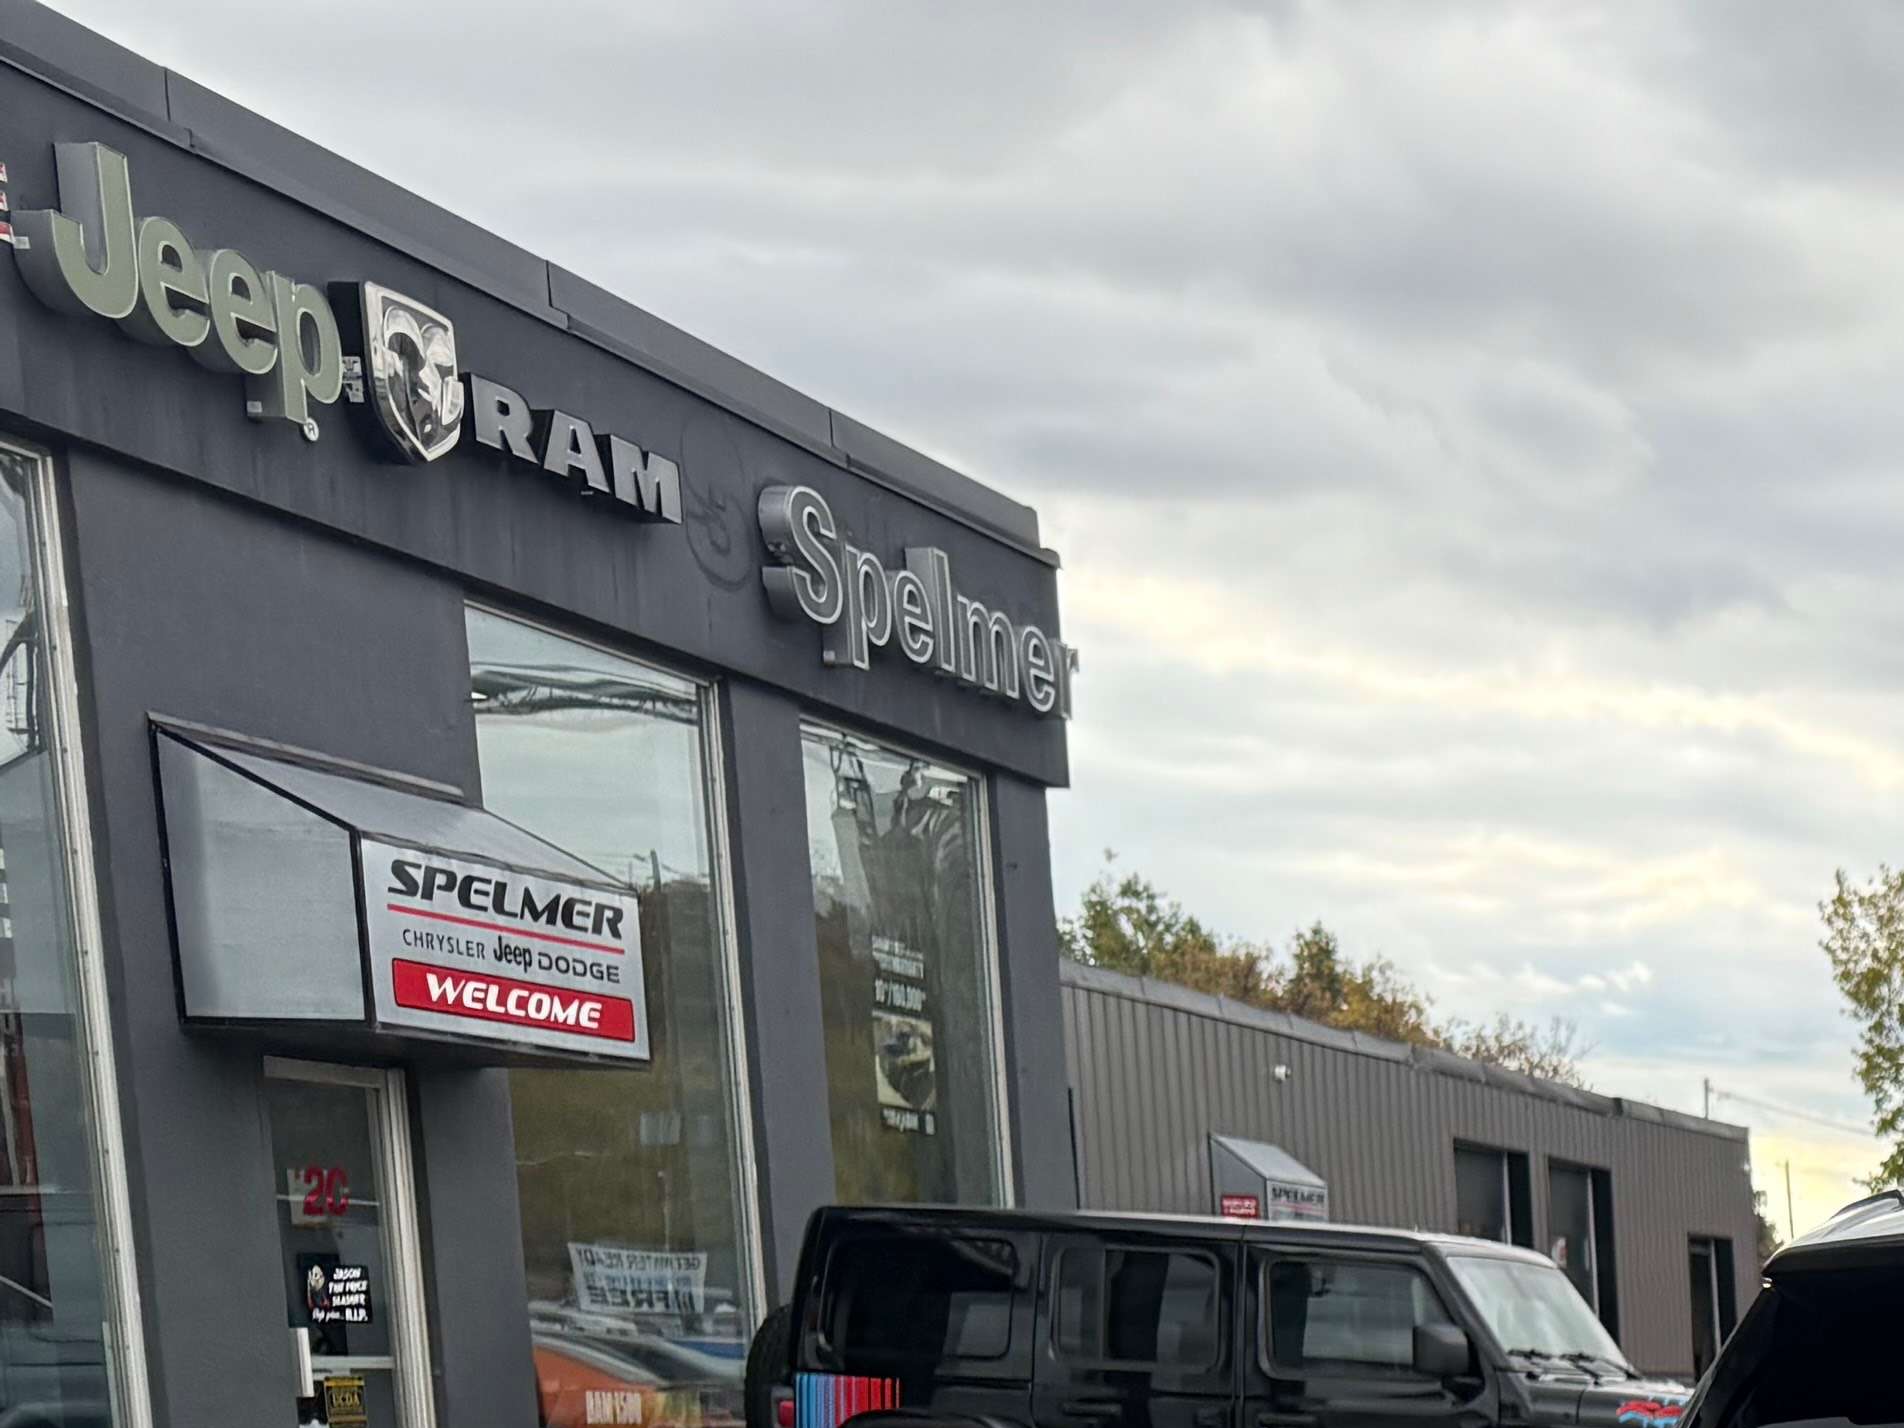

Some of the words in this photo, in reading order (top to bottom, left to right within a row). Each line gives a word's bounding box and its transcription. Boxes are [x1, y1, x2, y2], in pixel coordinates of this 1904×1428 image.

[14, 142, 342, 425] Jeep
[470, 372, 684, 525] RAM
[760, 486, 1080, 720] Spelmer
[387, 859, 625, 941] SPELMER
[402, 928, 486, 960] CHRYSLER
[493, 935, 533, 973] Jeep
[538, 951, 621, 984] DODGE
[426, 973, 602, 1029] WELCOME
